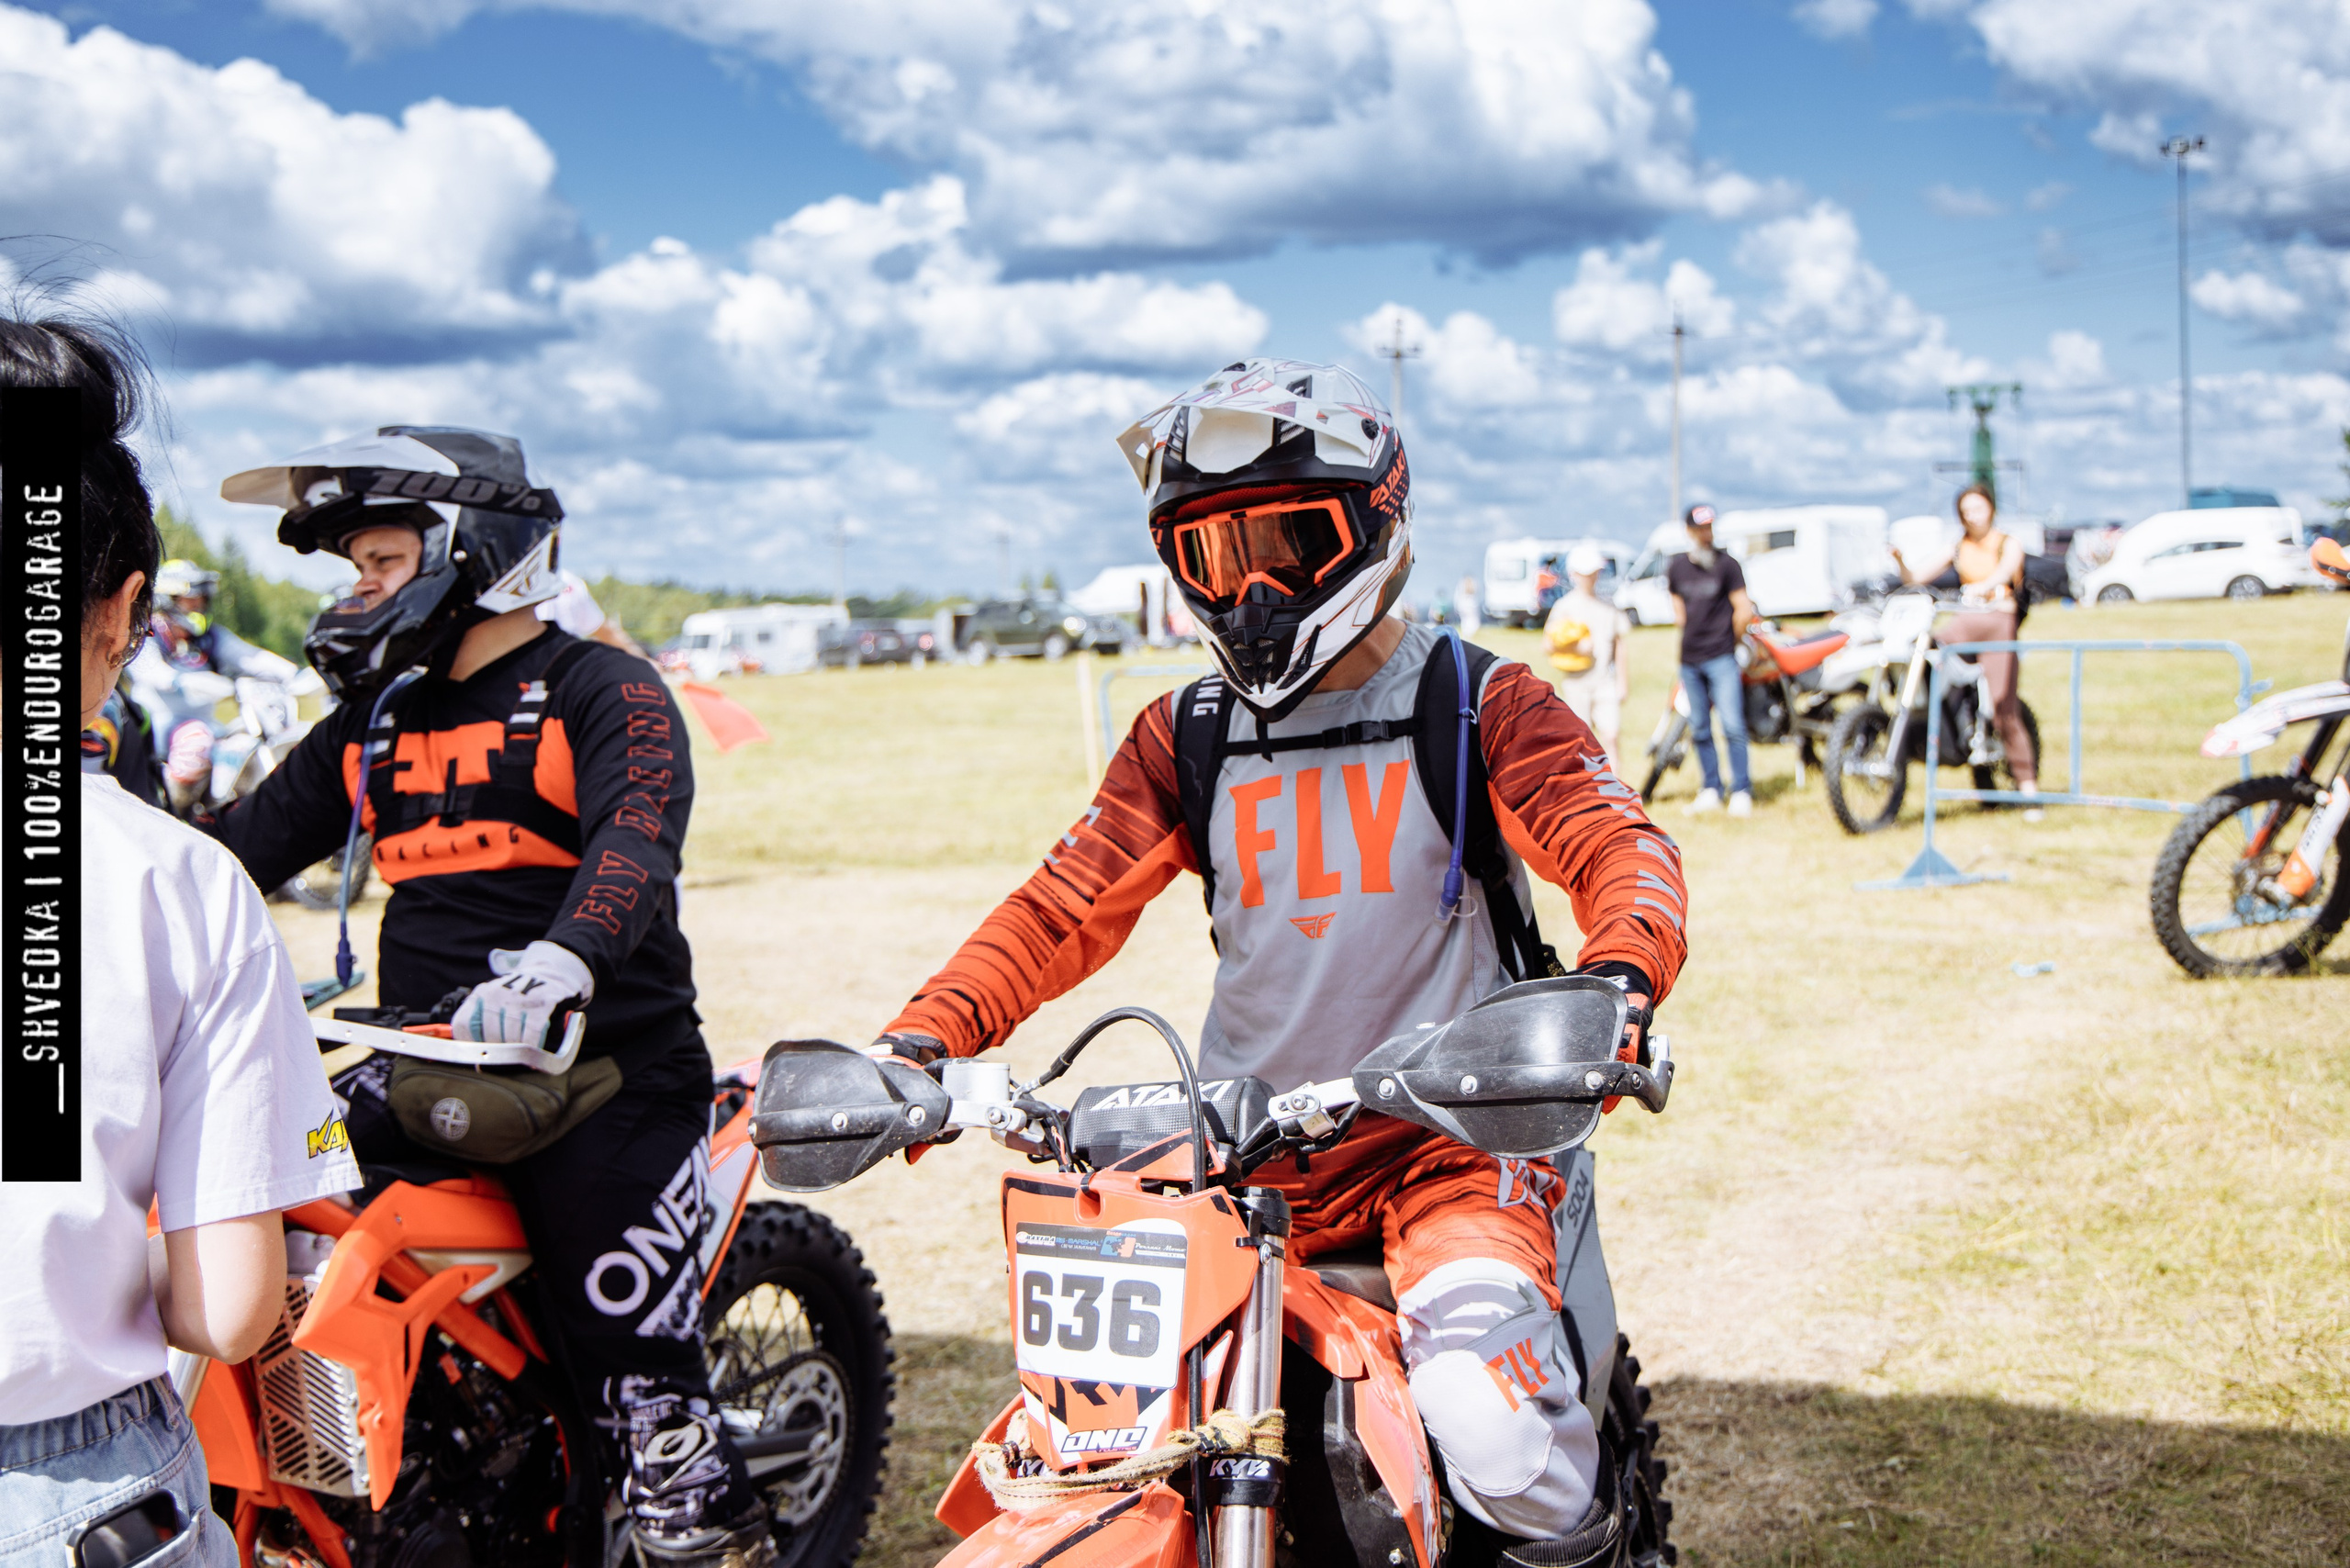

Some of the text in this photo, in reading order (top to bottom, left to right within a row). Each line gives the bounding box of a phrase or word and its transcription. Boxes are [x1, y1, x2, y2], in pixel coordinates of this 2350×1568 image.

[369, 470, 542, 511] 100%
[1192, 674, 1225, 717] ING
[1228, 759, 1411, 909] FLY
[573, 849, 649, 935] FLY
[1023, 1270, 1161, 1358] 636
[1483, 1338, 1550, 1414] FLY
[1209, 1458, 1270, 1478] KYB
